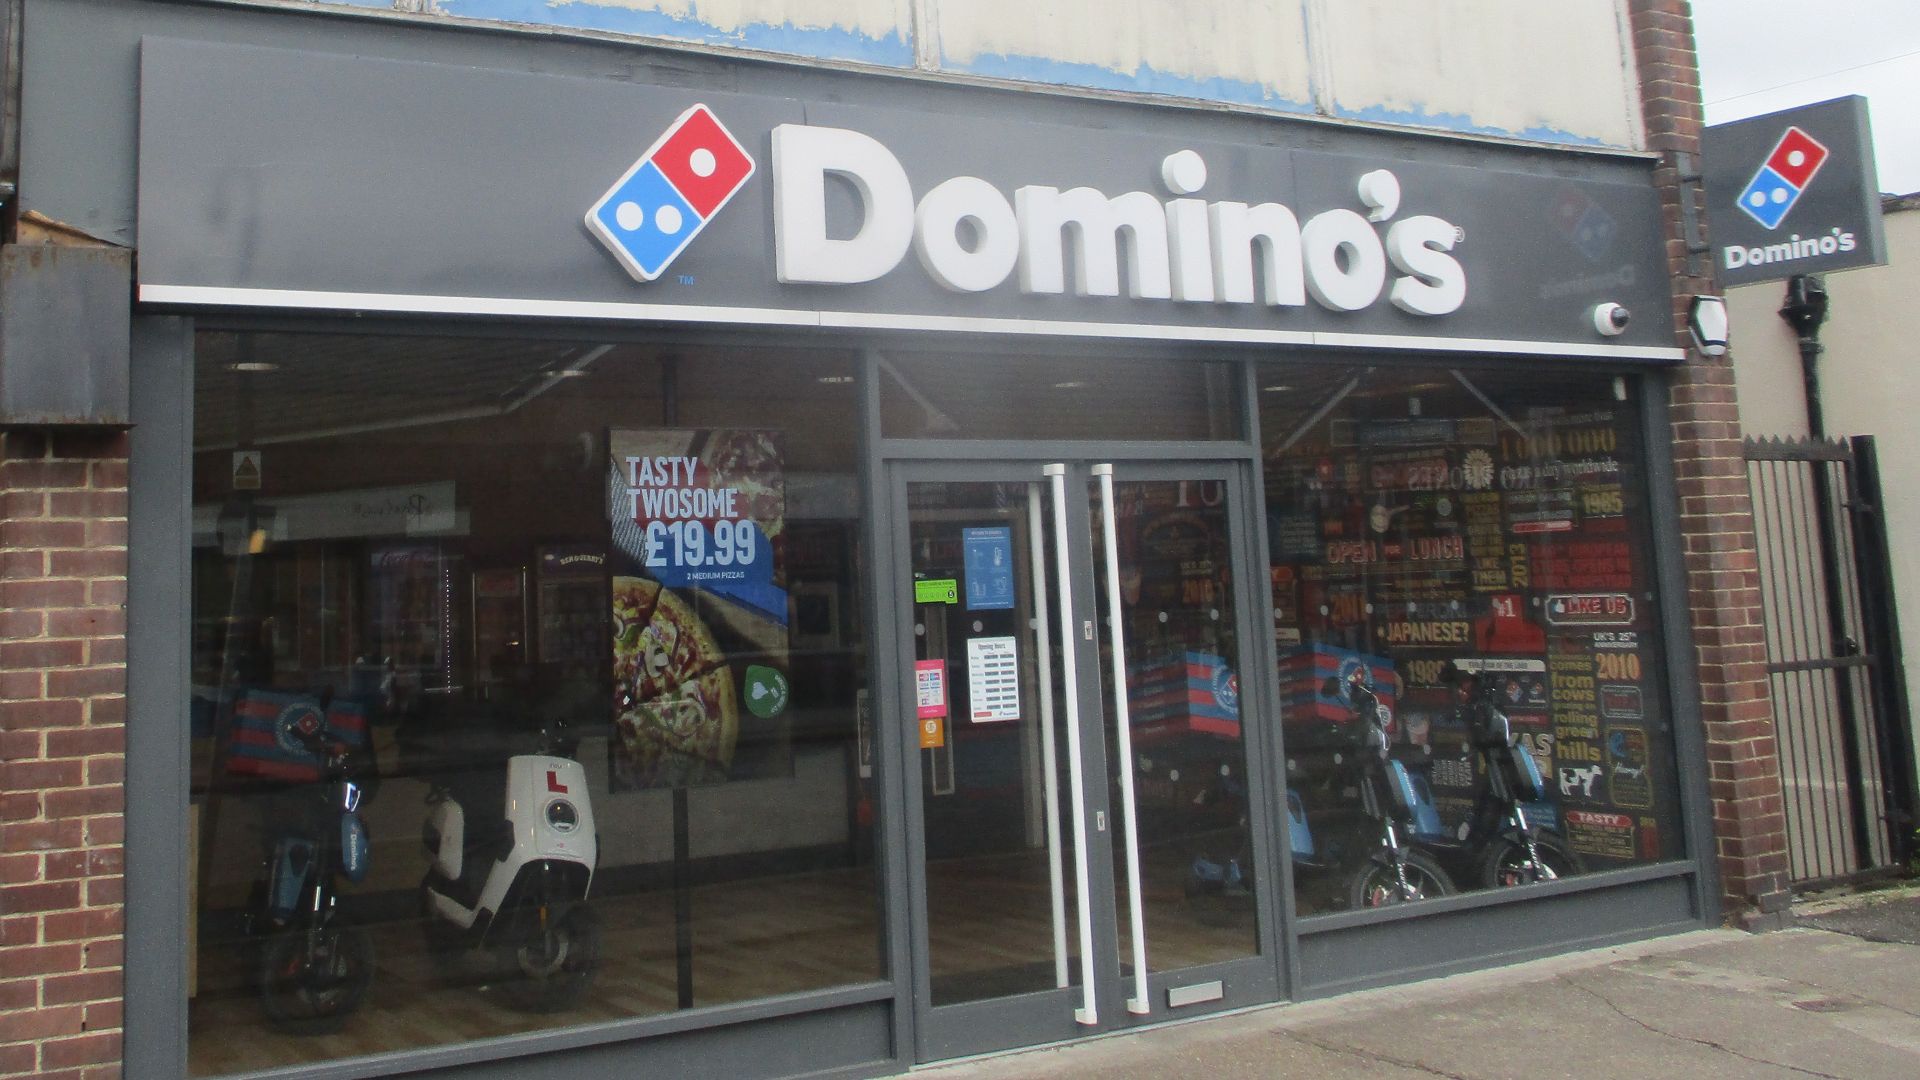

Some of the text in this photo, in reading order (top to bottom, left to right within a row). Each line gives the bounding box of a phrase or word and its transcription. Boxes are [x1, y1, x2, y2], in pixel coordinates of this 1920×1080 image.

[771, 123, 1467, 315] Domino's
[1723, 227, 1857, 269] Domino's
[626, 456, 698, 487] TASTY
[626, 488, 738, 519] TWOSOME
[645, 519, 756, 568] £19.99
[1410, 536, 1464, 560] LUNCH
[687, 571, 745, 580] 2 MEDIUM PIZZAS
[1567, 598, 1627, 614] LIKE US
[1387, 622, 1470, 642] JAPANESE?
[1595, 652, 1641, 681] 2010
[1552, 672, 1594, 688] from
[1552, 689, 1596, 701] cows
[1554, 712, 1598, 727] rolling
[1555, 726, 1599, 740] green
[1556, 740, 1602, 762] hills
[546, 770, 569, 794] L
[1578, 813, 1619, 825] TASTY
